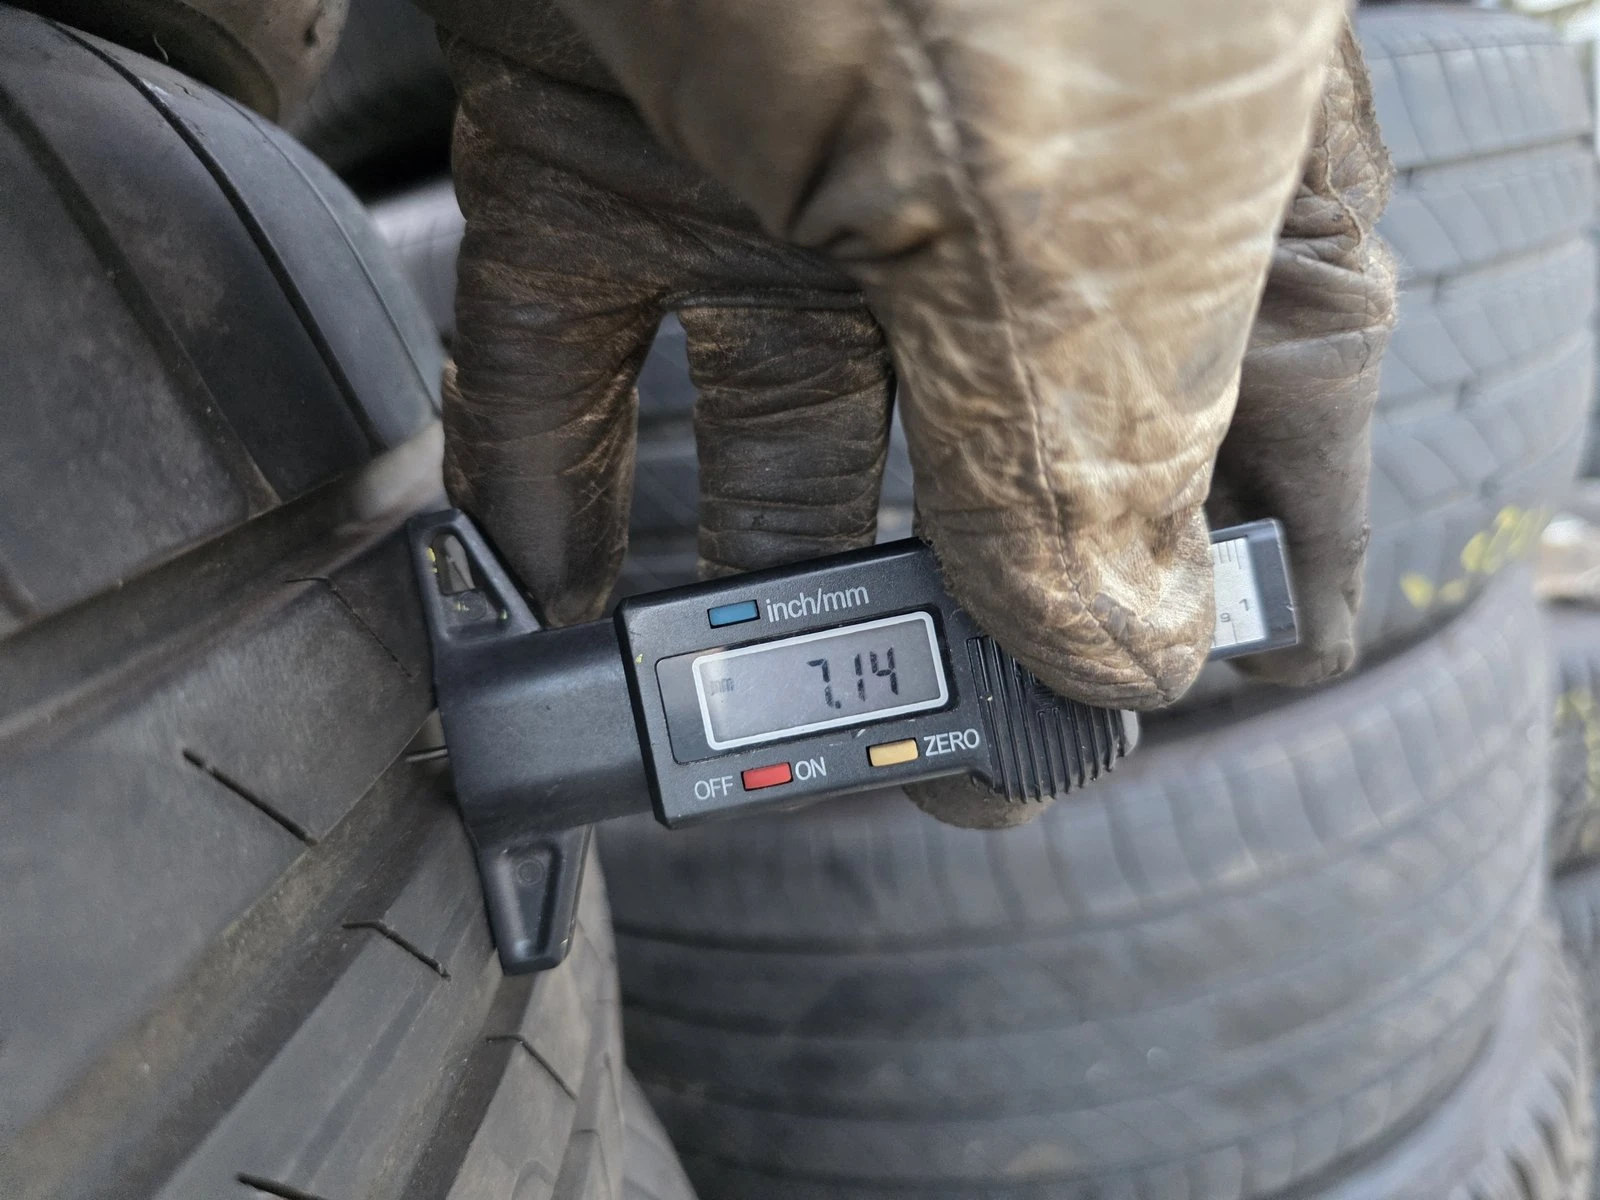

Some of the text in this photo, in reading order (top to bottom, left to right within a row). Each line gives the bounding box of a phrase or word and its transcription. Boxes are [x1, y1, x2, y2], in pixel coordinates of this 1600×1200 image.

[766, 586, 870, 623] inch/mm
[1239, 598, 1249, 612] 1
[807, 647, 899, 709] 7.14
[923, 728, 980, 757] ZERO
[795, 756, 827, 781] ON
[694, 775, 733, 800] OFF
